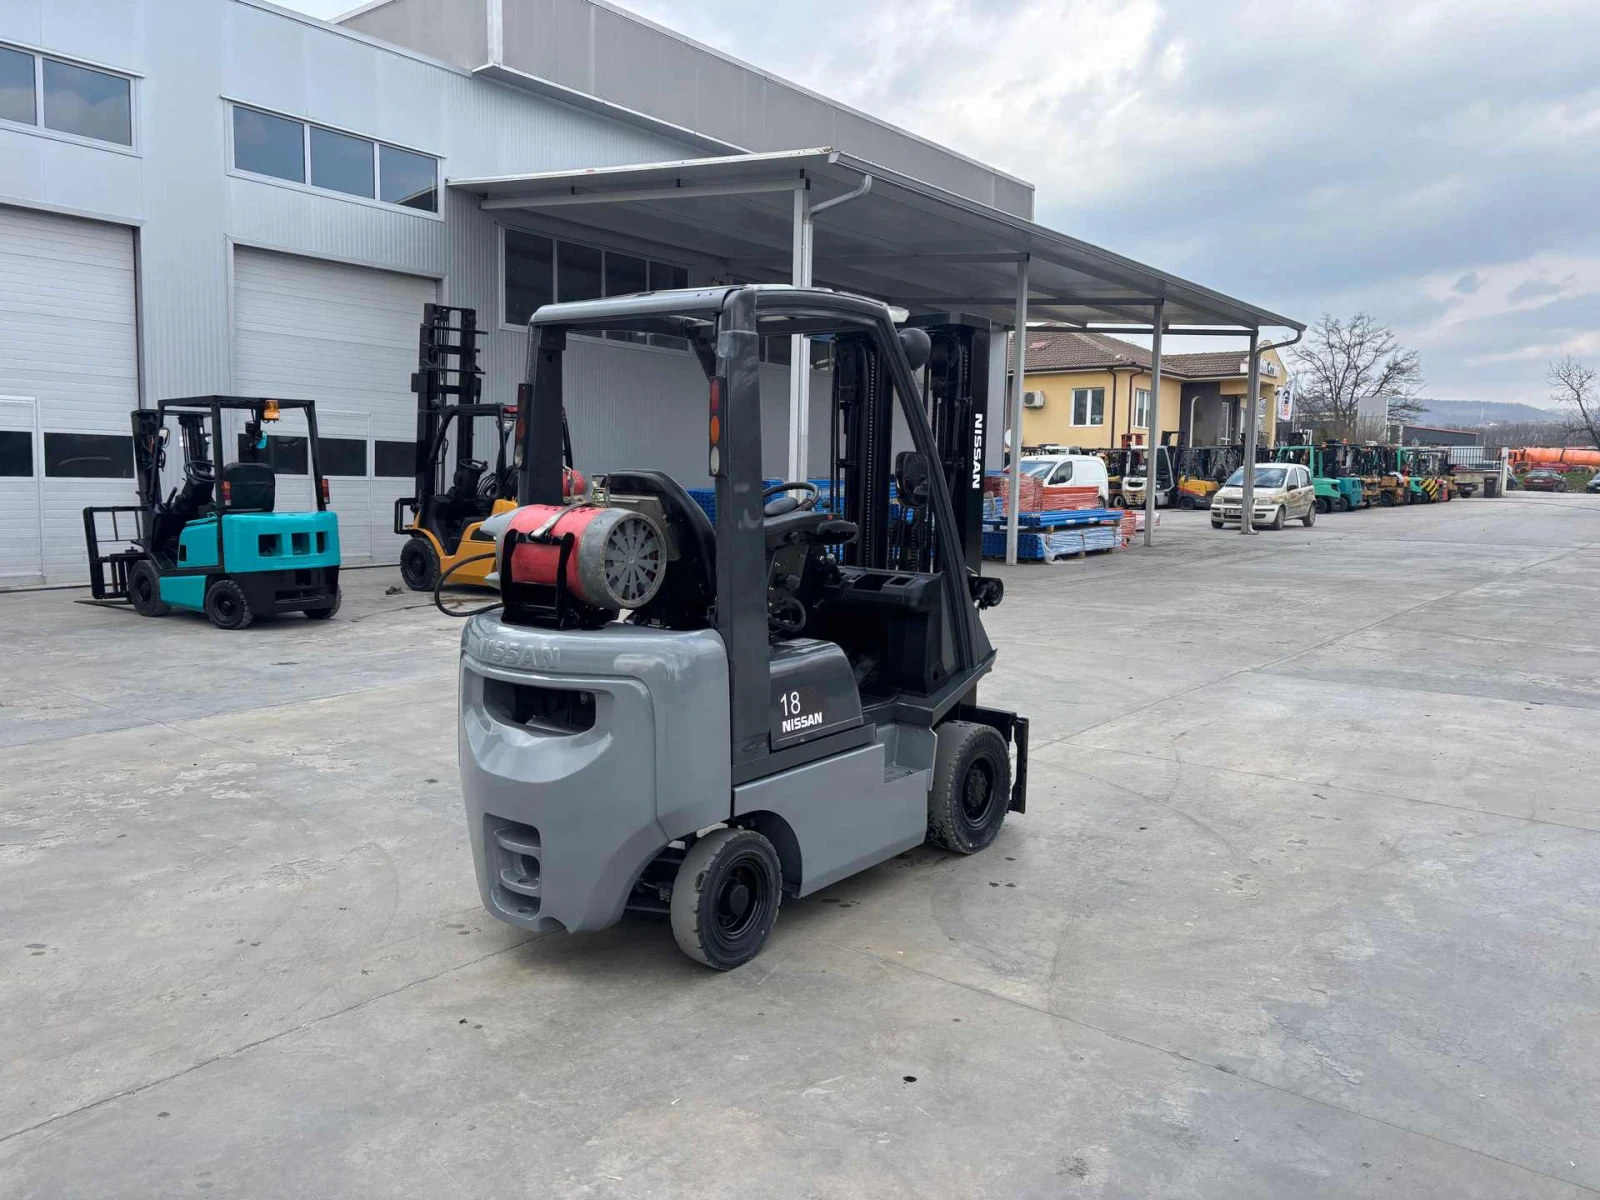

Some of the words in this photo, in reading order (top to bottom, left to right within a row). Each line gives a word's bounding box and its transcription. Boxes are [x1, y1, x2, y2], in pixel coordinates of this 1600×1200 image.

[972, 413, 983, 489] NISSAN
[476, 638, 560, 669] NISSAN
[780, 691, 801, 717] 18
[782, 711, 823, 733] NISSAN
